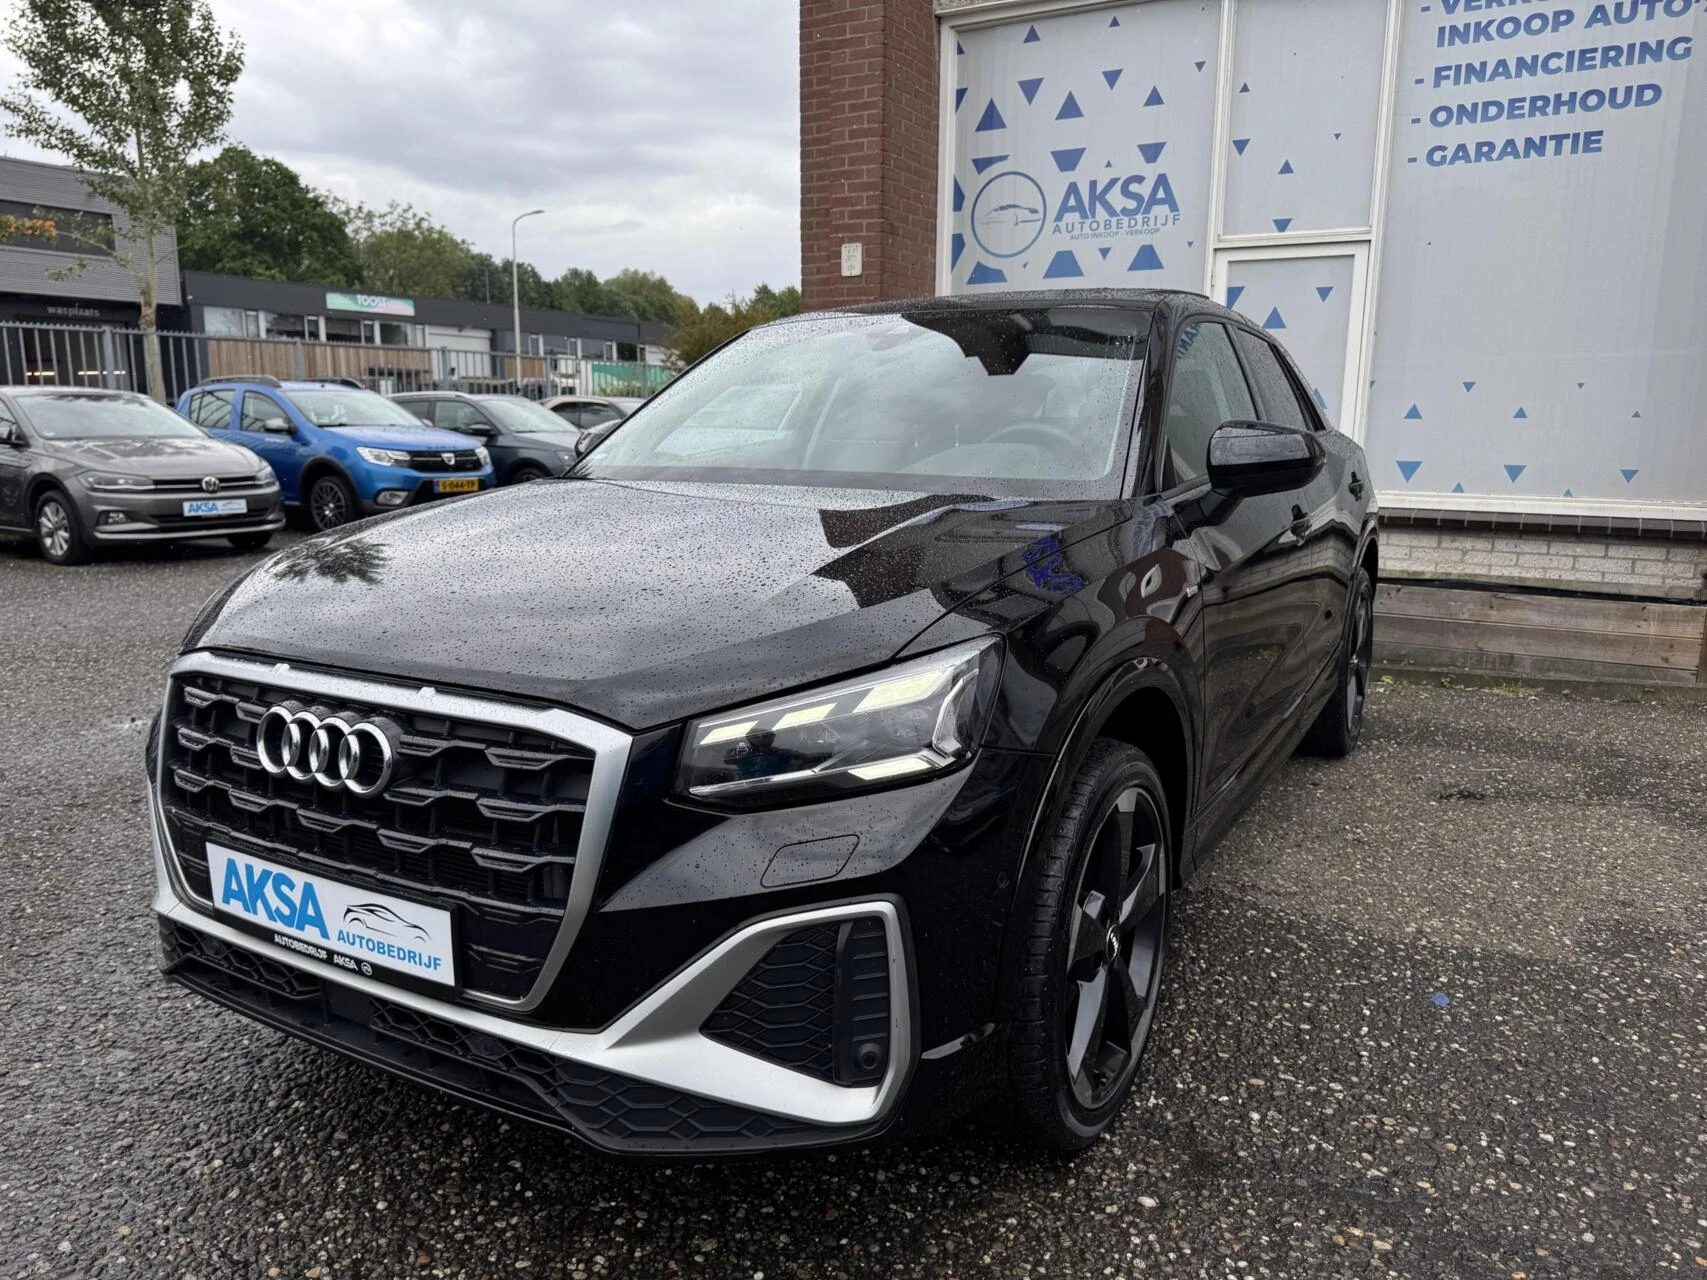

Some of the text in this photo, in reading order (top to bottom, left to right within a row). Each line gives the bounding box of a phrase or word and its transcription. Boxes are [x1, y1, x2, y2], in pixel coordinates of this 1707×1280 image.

[1437, 9, 1575, 48] INKOOP
[1584, 0, 1707, 29] AUTO
[1433, 35, 1694, 88] FINANCIERING
[1429, 83, 1663, 128] ONDERHOUD
[1425, 130, 1604, 167] GARANTIE
[1053, 173, 1180, 223] AKSA
[1052, 213, 1181, 235] AUTOBEDRIJF
[1069, 232, 1090, 241] AUTO
[1091, 230, 1119, 239] INKOOP
[1125, 227, 1161, 237] VERKOOP
[46, 302, 100, 317] wasplaats
[187, 502, 219, 514] AKSA
[222, 857, 331, 941] AKSA
[274, 933, 359, 971] AUTOBEDRIJF AKSA
[337, 929, 442, 971] AUTOBEDRIJF
